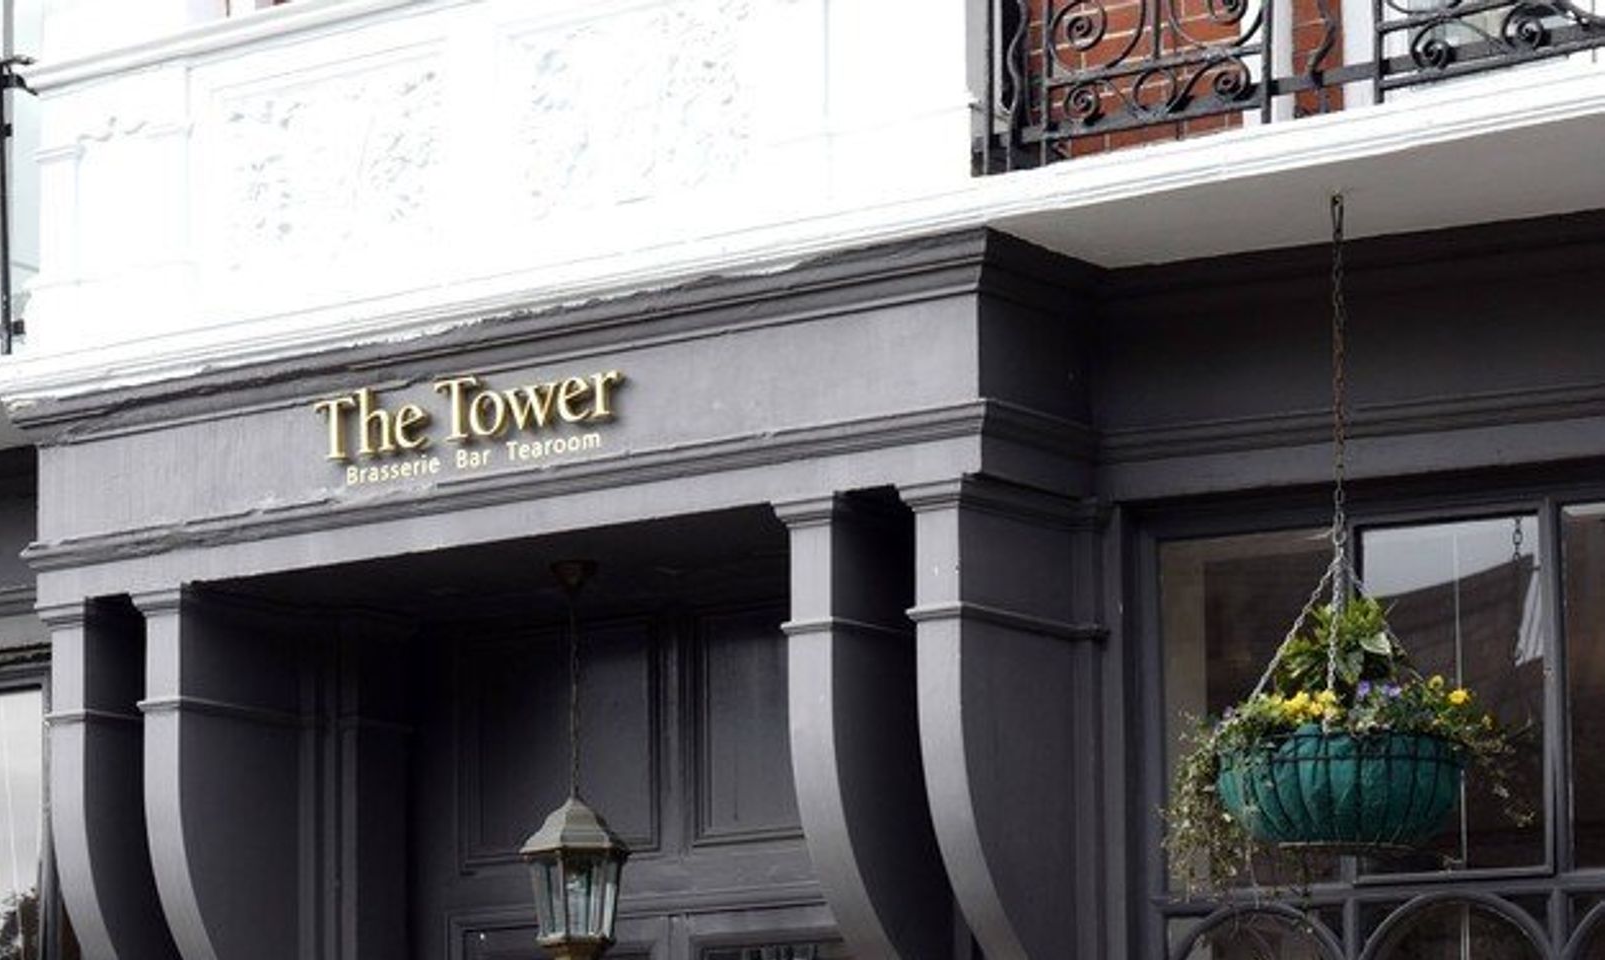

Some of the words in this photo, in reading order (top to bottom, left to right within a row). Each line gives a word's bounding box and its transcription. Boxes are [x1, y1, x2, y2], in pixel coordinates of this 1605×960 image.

[314, 387, 430, 460] The
[435, 370, 623, 442] Tower
[346, 454, 442, 486] Brasserie
[456, 447, 492, 470] Bar
[506, 432, 602, 462] Tearoom
